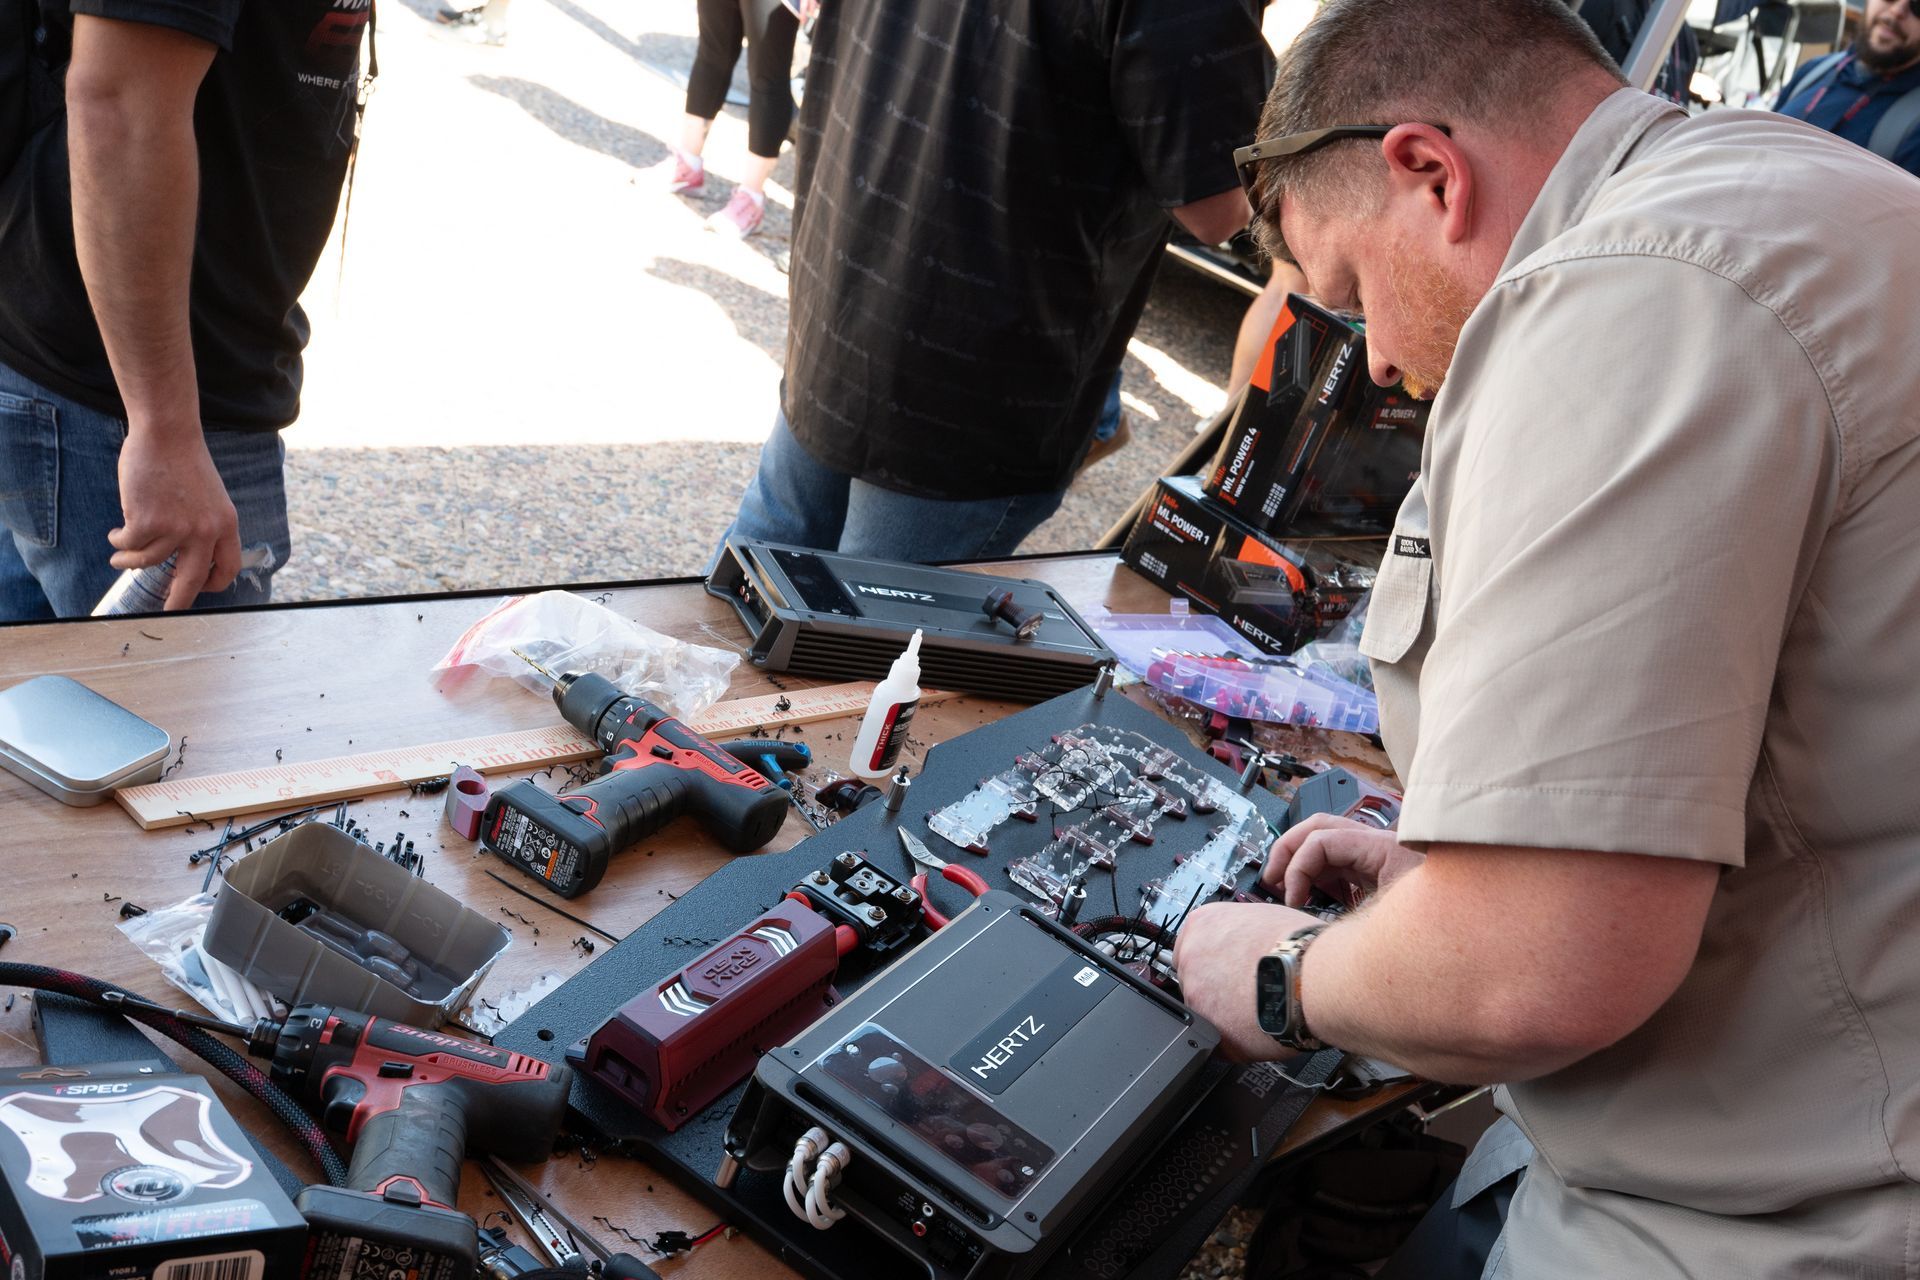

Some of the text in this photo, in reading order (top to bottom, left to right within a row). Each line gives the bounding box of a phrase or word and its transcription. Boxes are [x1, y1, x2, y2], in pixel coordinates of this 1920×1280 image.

[298, 73, 340, 89] WHERE
[1318, 343, 1352, 405] HERTZ
[1222, 476, 1236, 493] ML
[1230, 435, 1254, 475] POWER
[1248, 427, 1257, 436] 4
[1157, 505, 1170, 520] ML
[1170, 514, 1204, 542] POWER
[1203, 535, 1210, 545] 1
[858, 585, 935, 602] HERTZ
[1233, 615, 1282, 651] HERTZ
[877, 723, 891, 751] THICK
[473, 752, 518, 767] THE
[523, 741, 586, 761] HOME
[310, 1017, 323, 1029] 3
[971, 1015, 1045, 1079] HERTZ
[441, 1055, 500, 1077] BRUSHLESS
